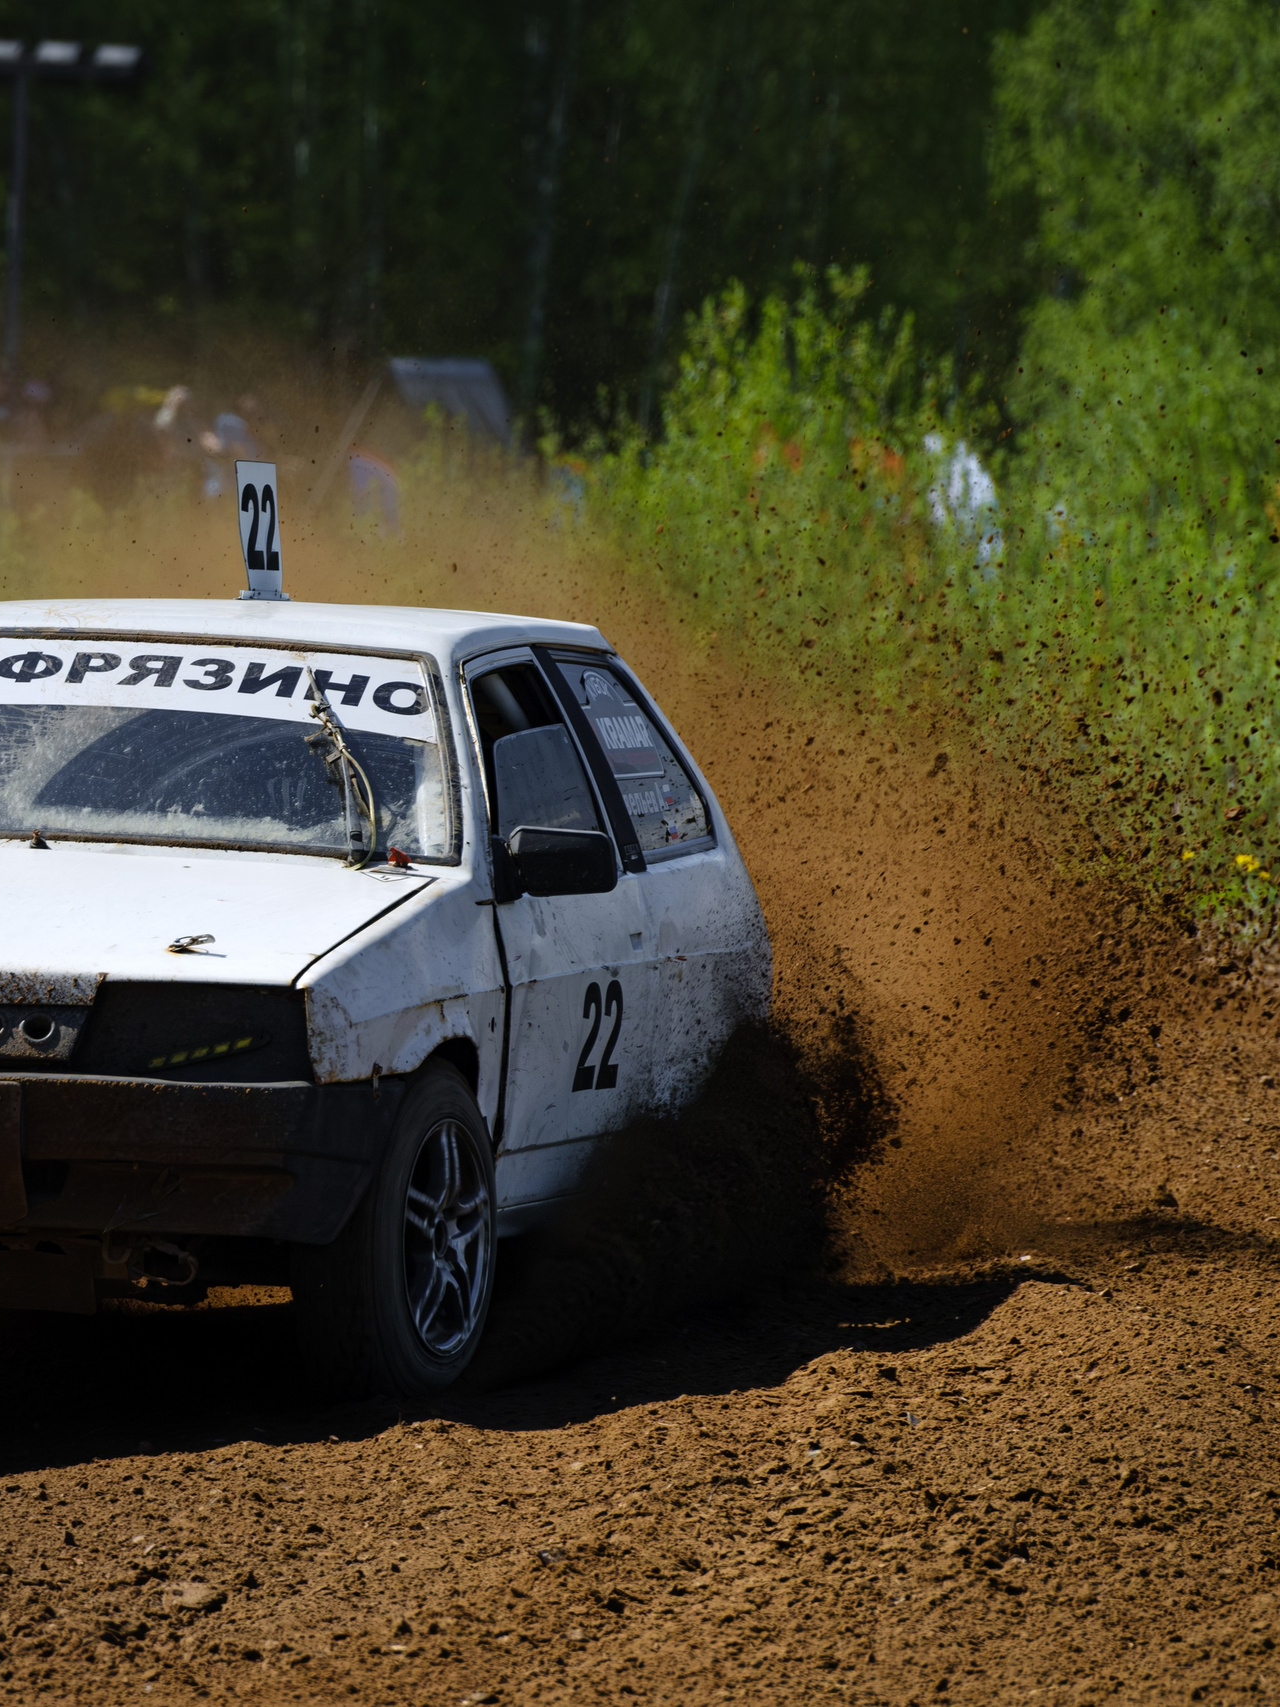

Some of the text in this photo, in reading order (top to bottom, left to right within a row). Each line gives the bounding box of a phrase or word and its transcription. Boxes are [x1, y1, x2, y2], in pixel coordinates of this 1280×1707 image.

[241, 483, 280, 571] 22
[595, 716, 653, 750] KRAMAR
[572, 979, 623, 1093] 22
